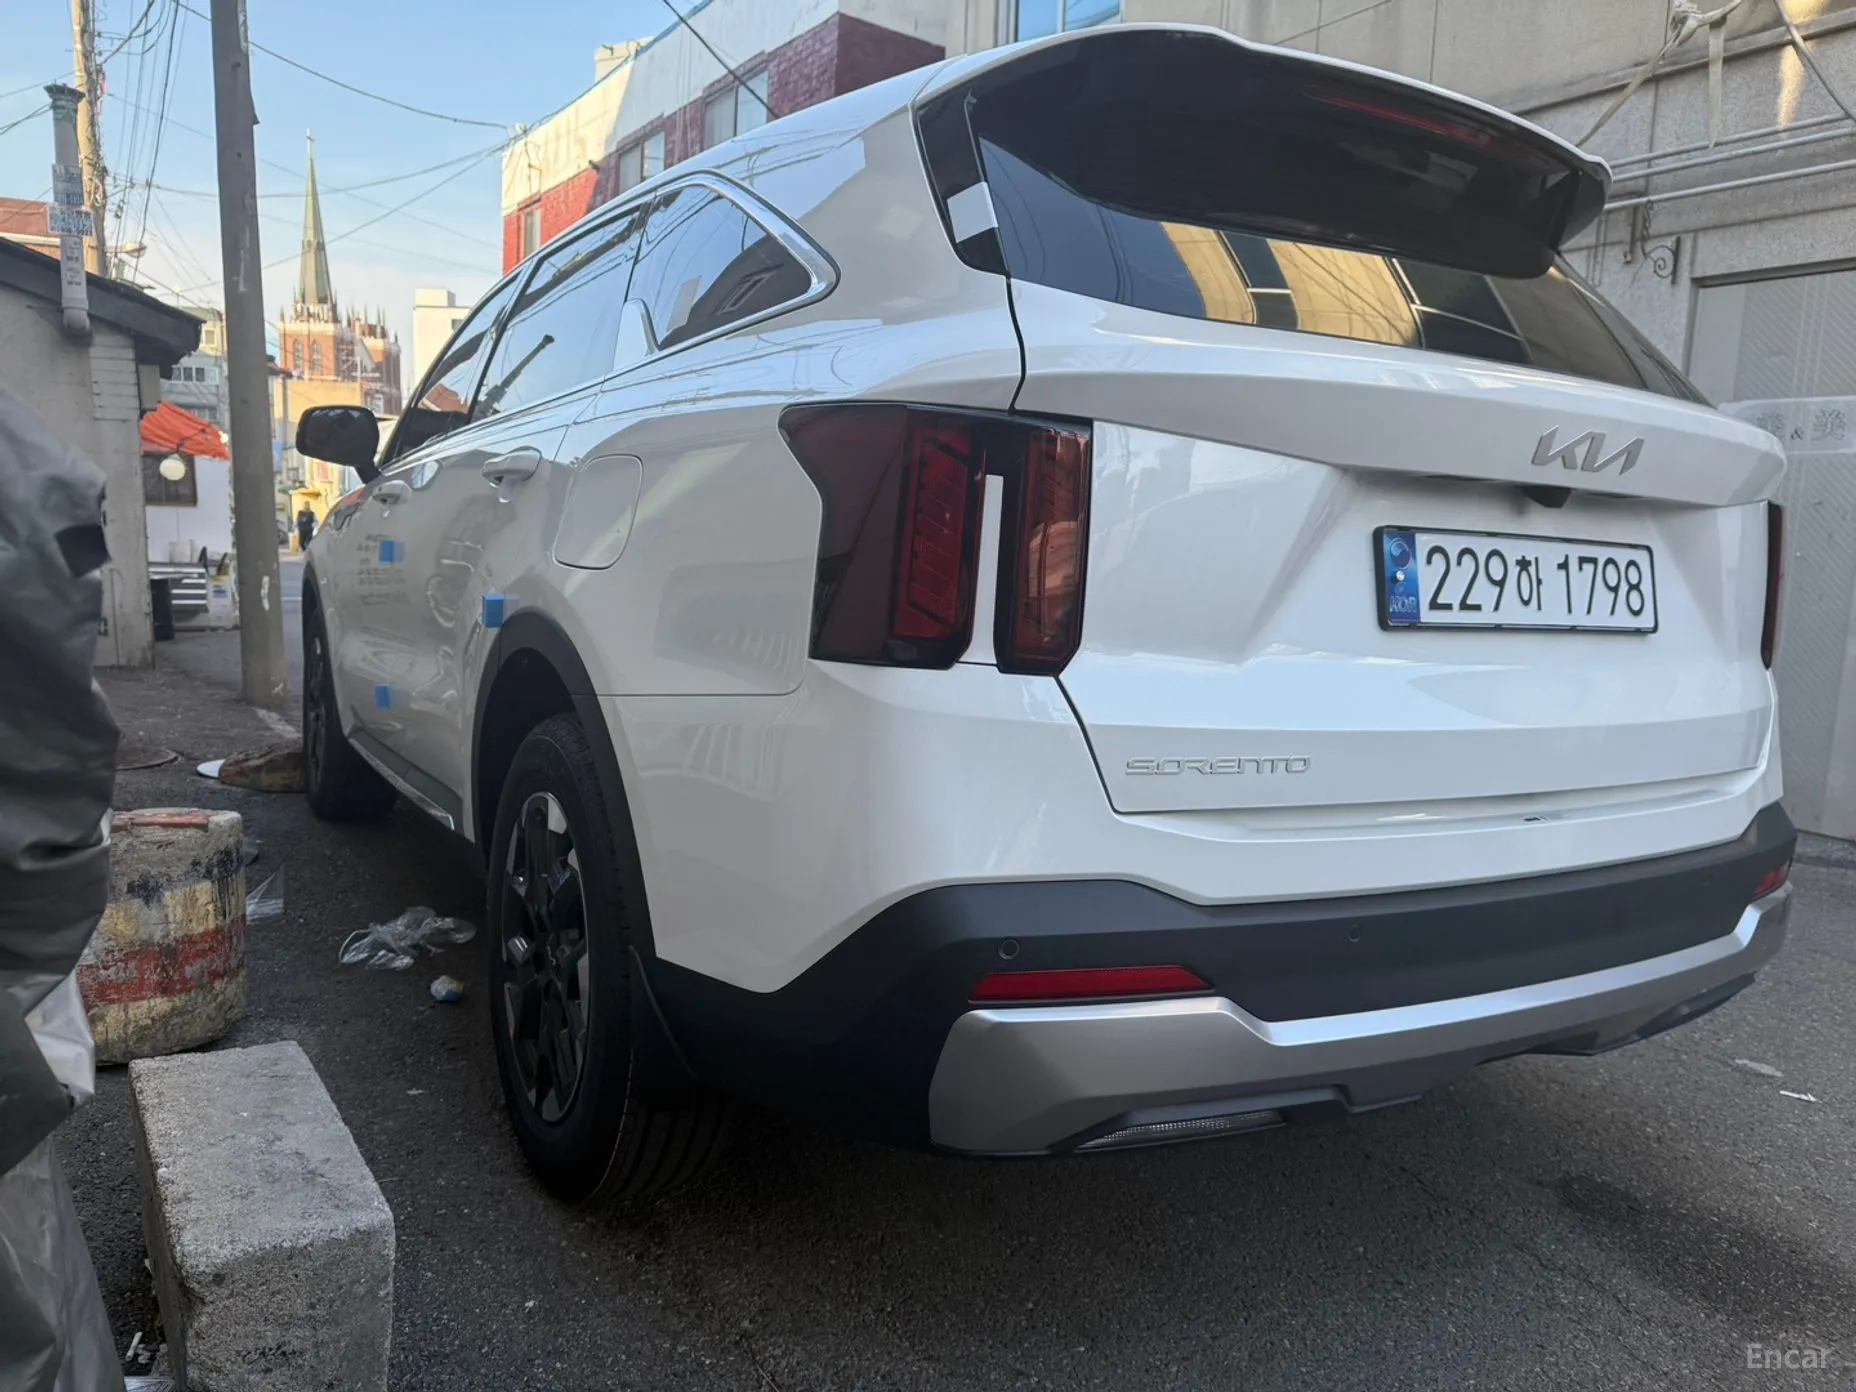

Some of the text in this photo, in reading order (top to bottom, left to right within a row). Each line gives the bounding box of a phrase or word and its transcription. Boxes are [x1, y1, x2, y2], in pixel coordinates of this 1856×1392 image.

[1531, 425, 1644, 475] KIA
[1425, 544, 1645, 617] 229하 1798
[1389, 595, 1417, 613] KOR
[1125, 756, 1311, 776] SORENTO
